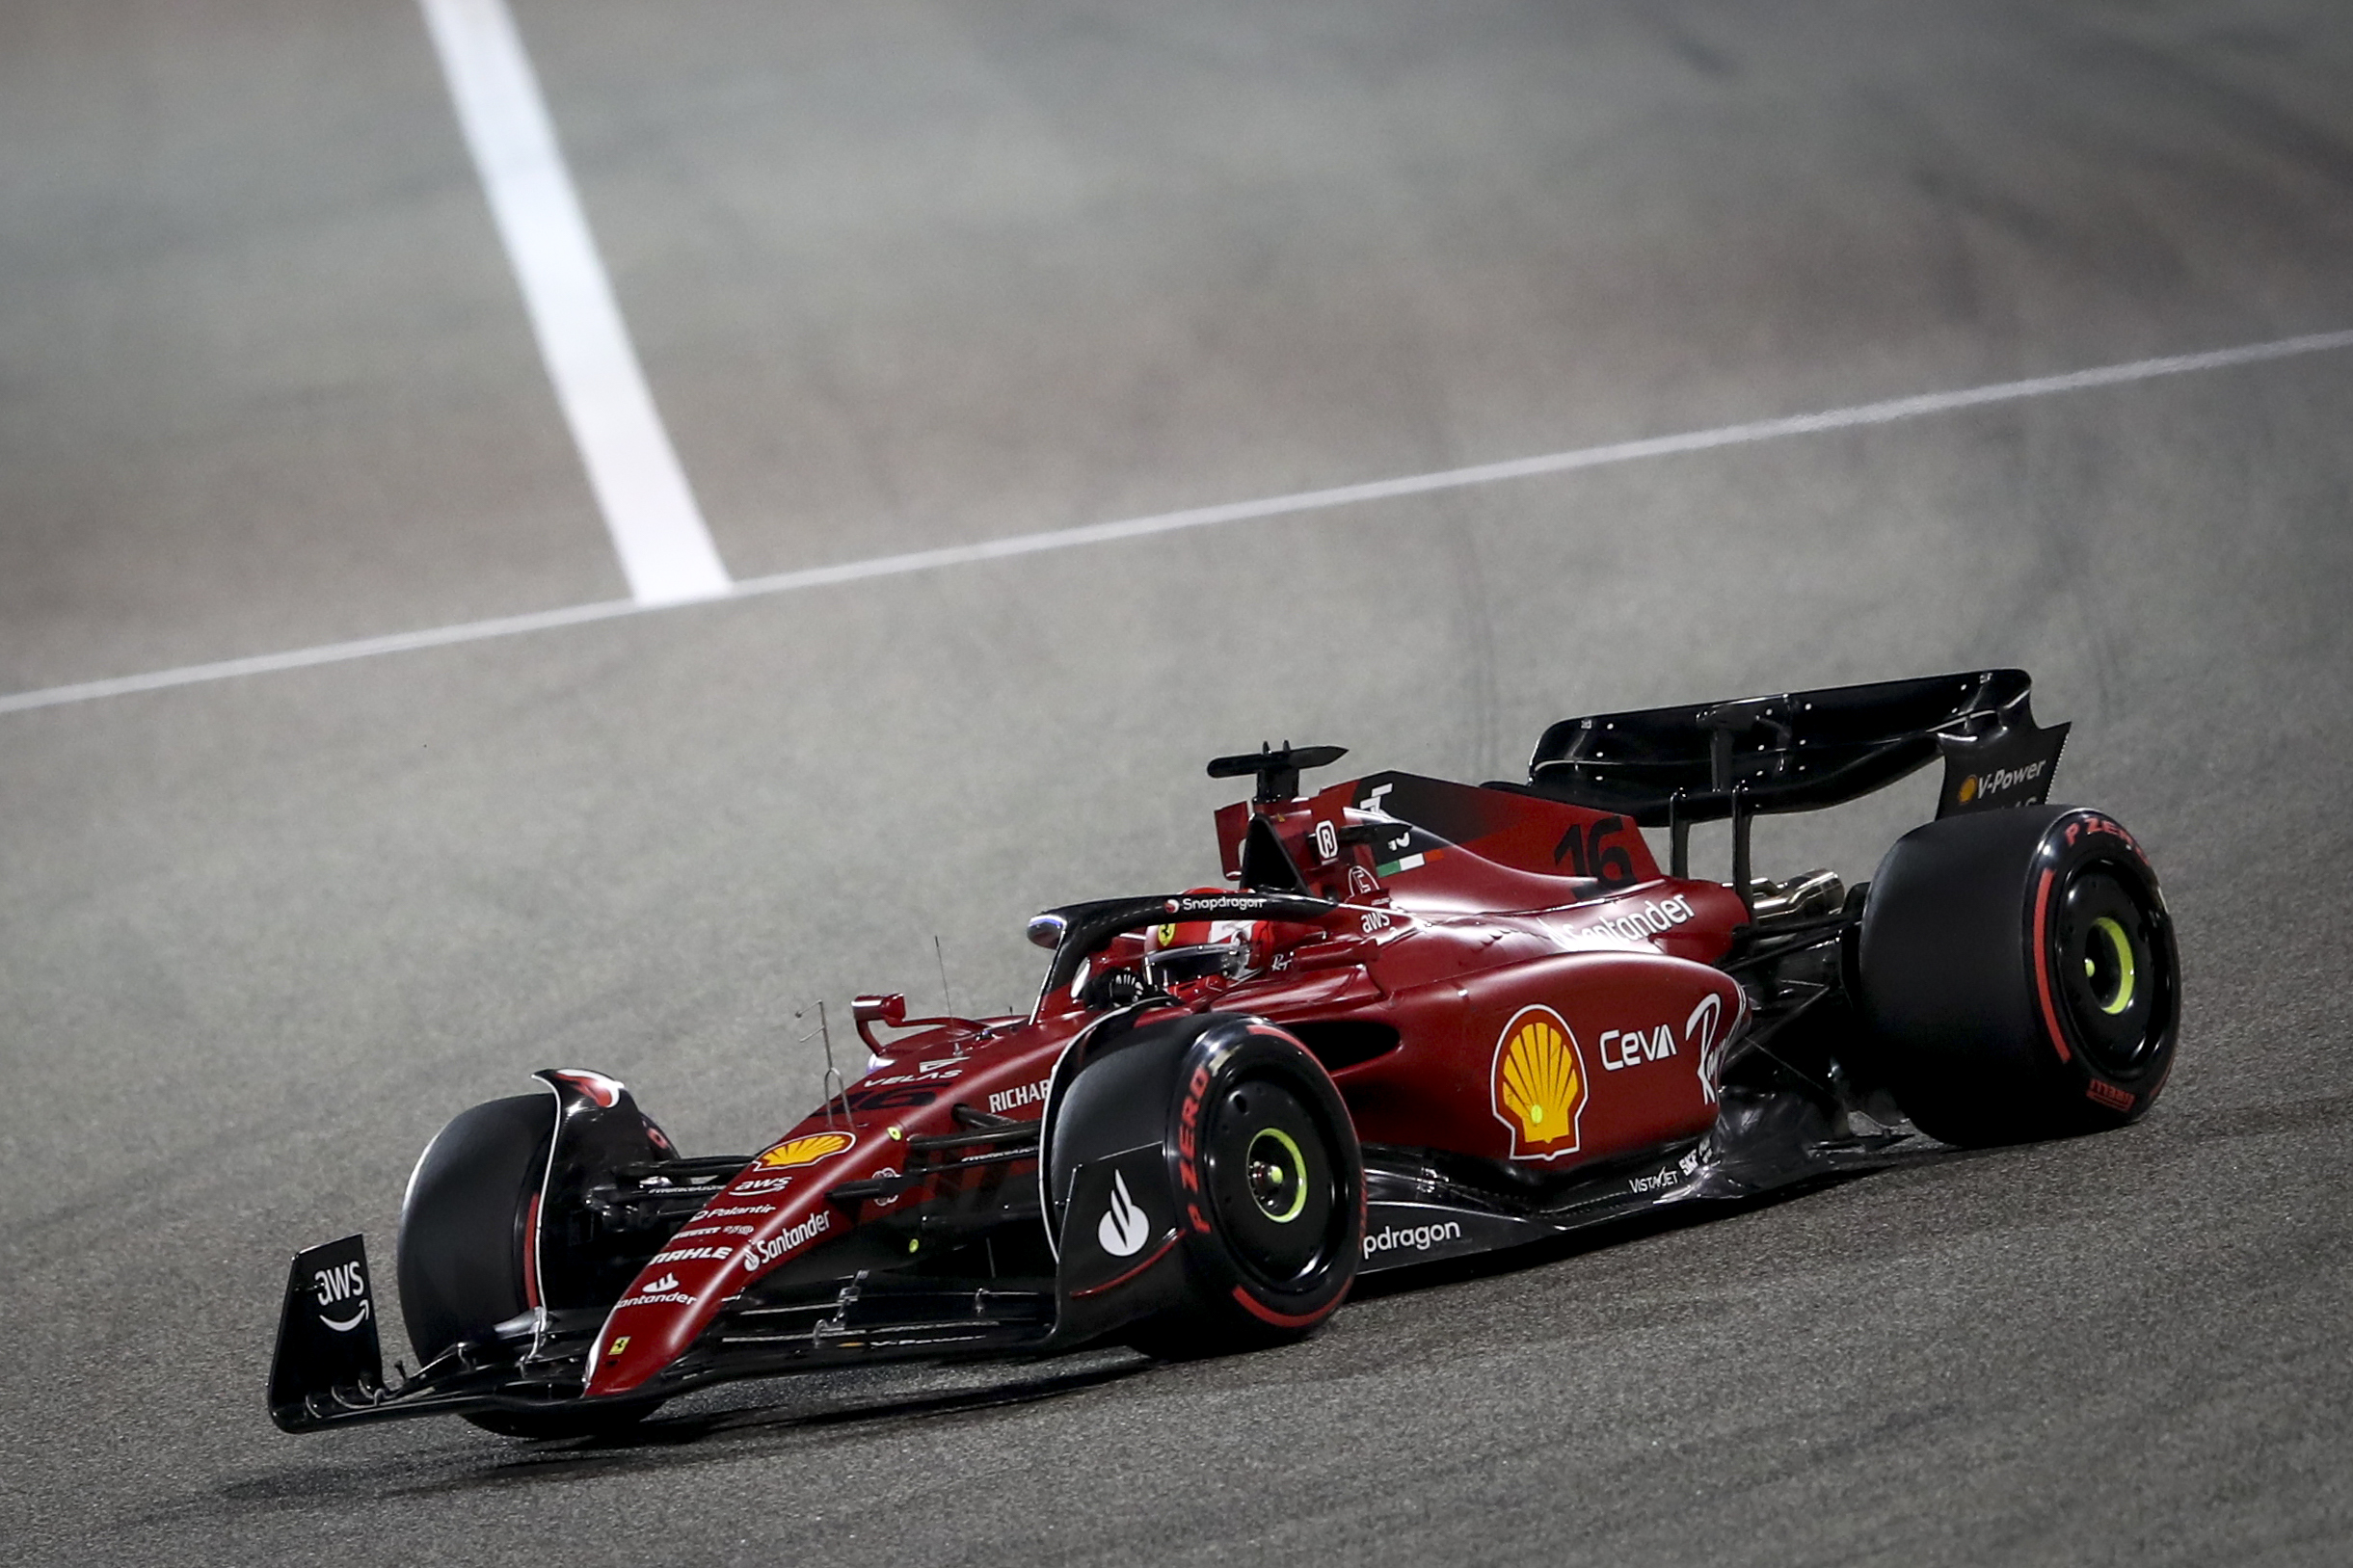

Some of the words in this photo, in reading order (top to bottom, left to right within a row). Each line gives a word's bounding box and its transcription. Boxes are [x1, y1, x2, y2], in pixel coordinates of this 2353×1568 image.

[1977, 759, 2046, 800] V-Power
[1554, 815, 1638, 899] 16
[1183, 896, 1263, 911] Snapdragon
[1360, 912, 1391, 934] aws
[864, 1069, 963, 1088] VELAS
[1179, 1065, 1211, 1195] ZERO
[734, 1176, 792, 1192] aws
[708, 1204, 777, 1219] Palantir
[1187, 1203, 1213, 1234] P
[756, 1209, 830, 1264] Santander
[1362, 1221, 1462, 1261] pdragon
[314, 1261, 365, 1307] aws
[615, 1291, 698, 1309] antander
